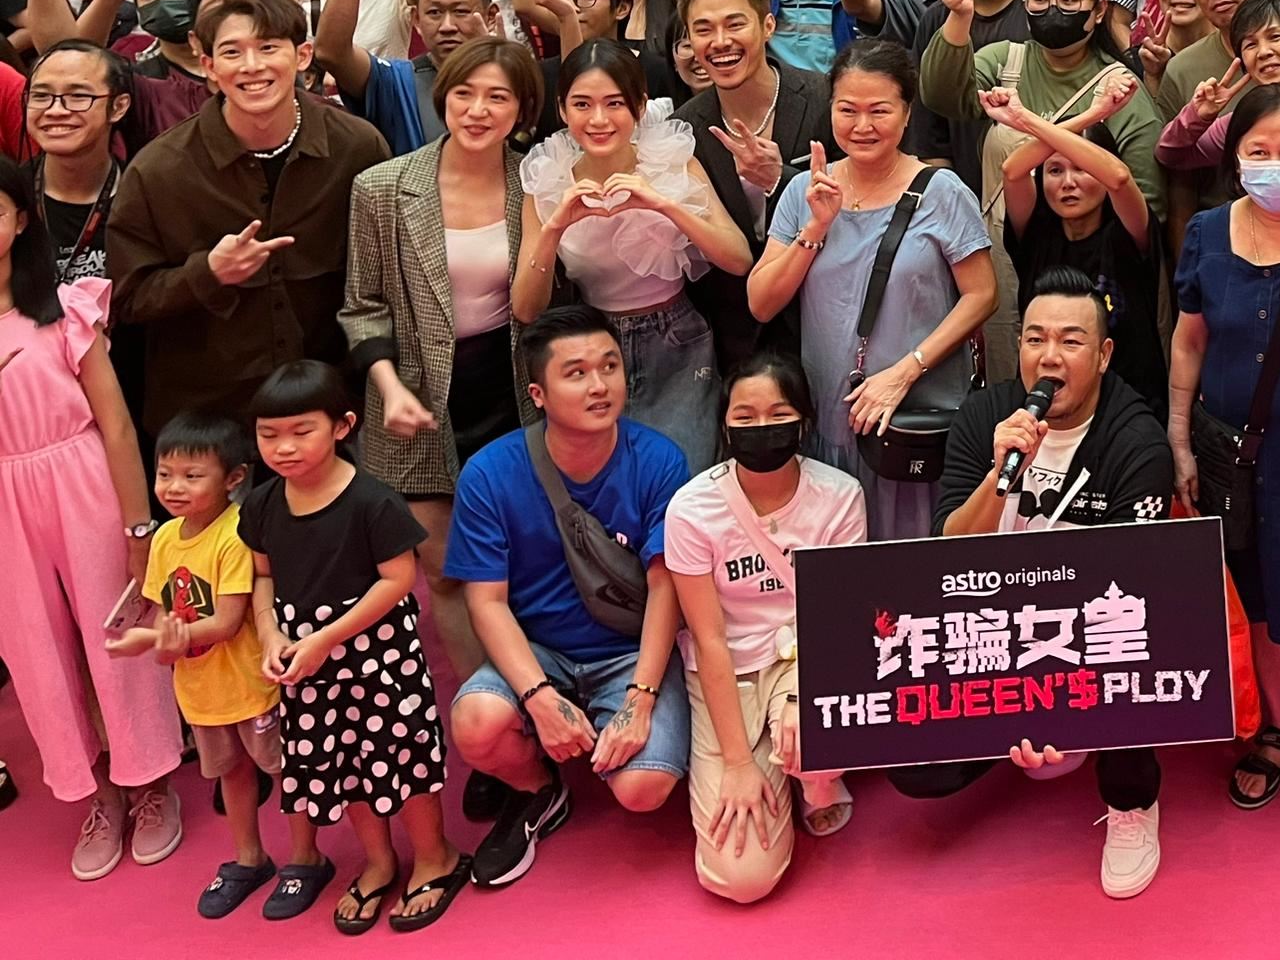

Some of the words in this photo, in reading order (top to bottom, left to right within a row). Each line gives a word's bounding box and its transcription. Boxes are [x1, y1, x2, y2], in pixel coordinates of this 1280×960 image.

[941, 570, 1002, 597] astro
[1005, 566, 1076, 587] originals
[873, 581, 1150, 680] 诈骗女皇
[814, 692, 892, 729] THE
[1104, 669, 1211, 704] PLOY
